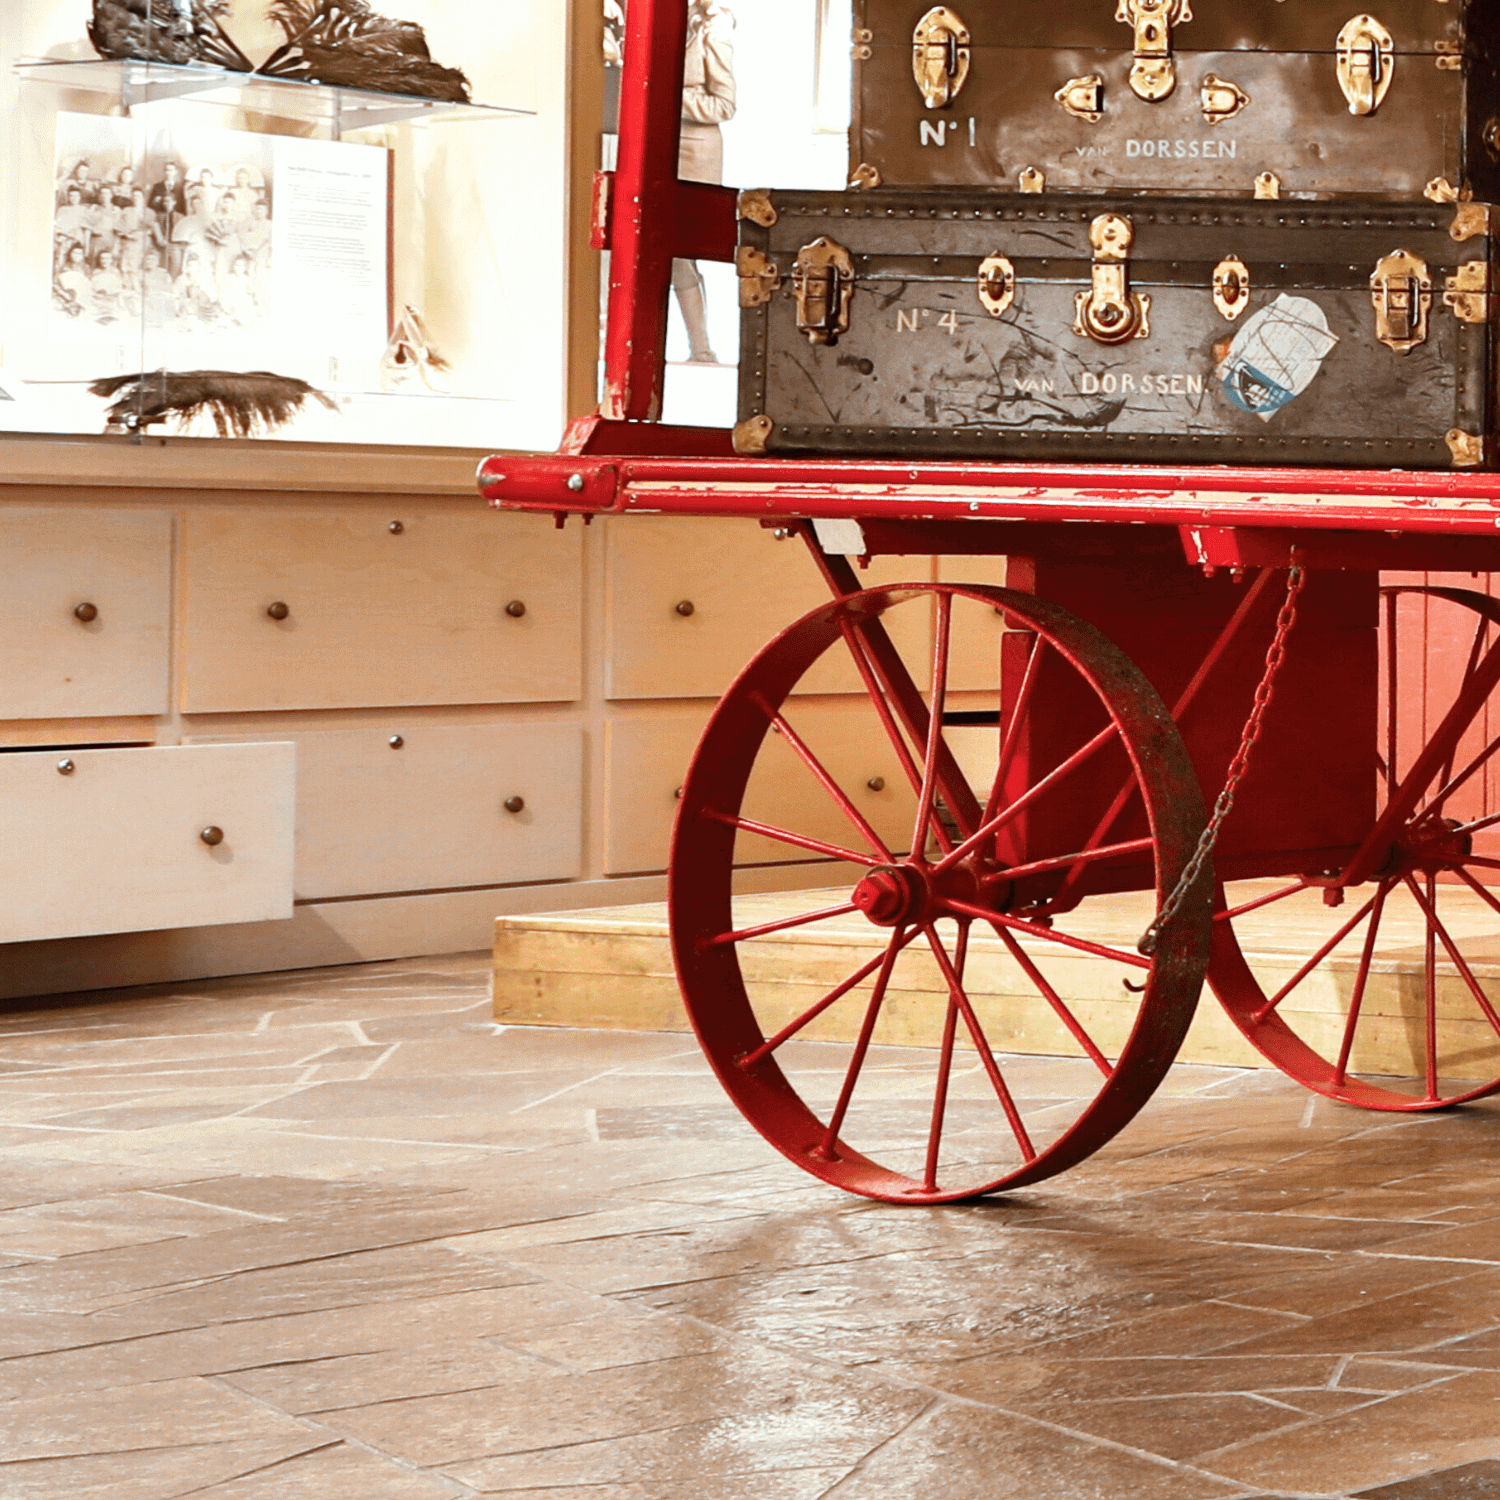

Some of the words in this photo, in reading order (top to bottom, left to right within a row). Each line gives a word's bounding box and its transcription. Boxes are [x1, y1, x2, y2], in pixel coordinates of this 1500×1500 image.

[1075, 146, 1108, 158] VAN
[1126, 139, 1237, 159] DORSSEN
[937, 308, 959, 336] 4
[1013, 378, 1055, 393] VAN
